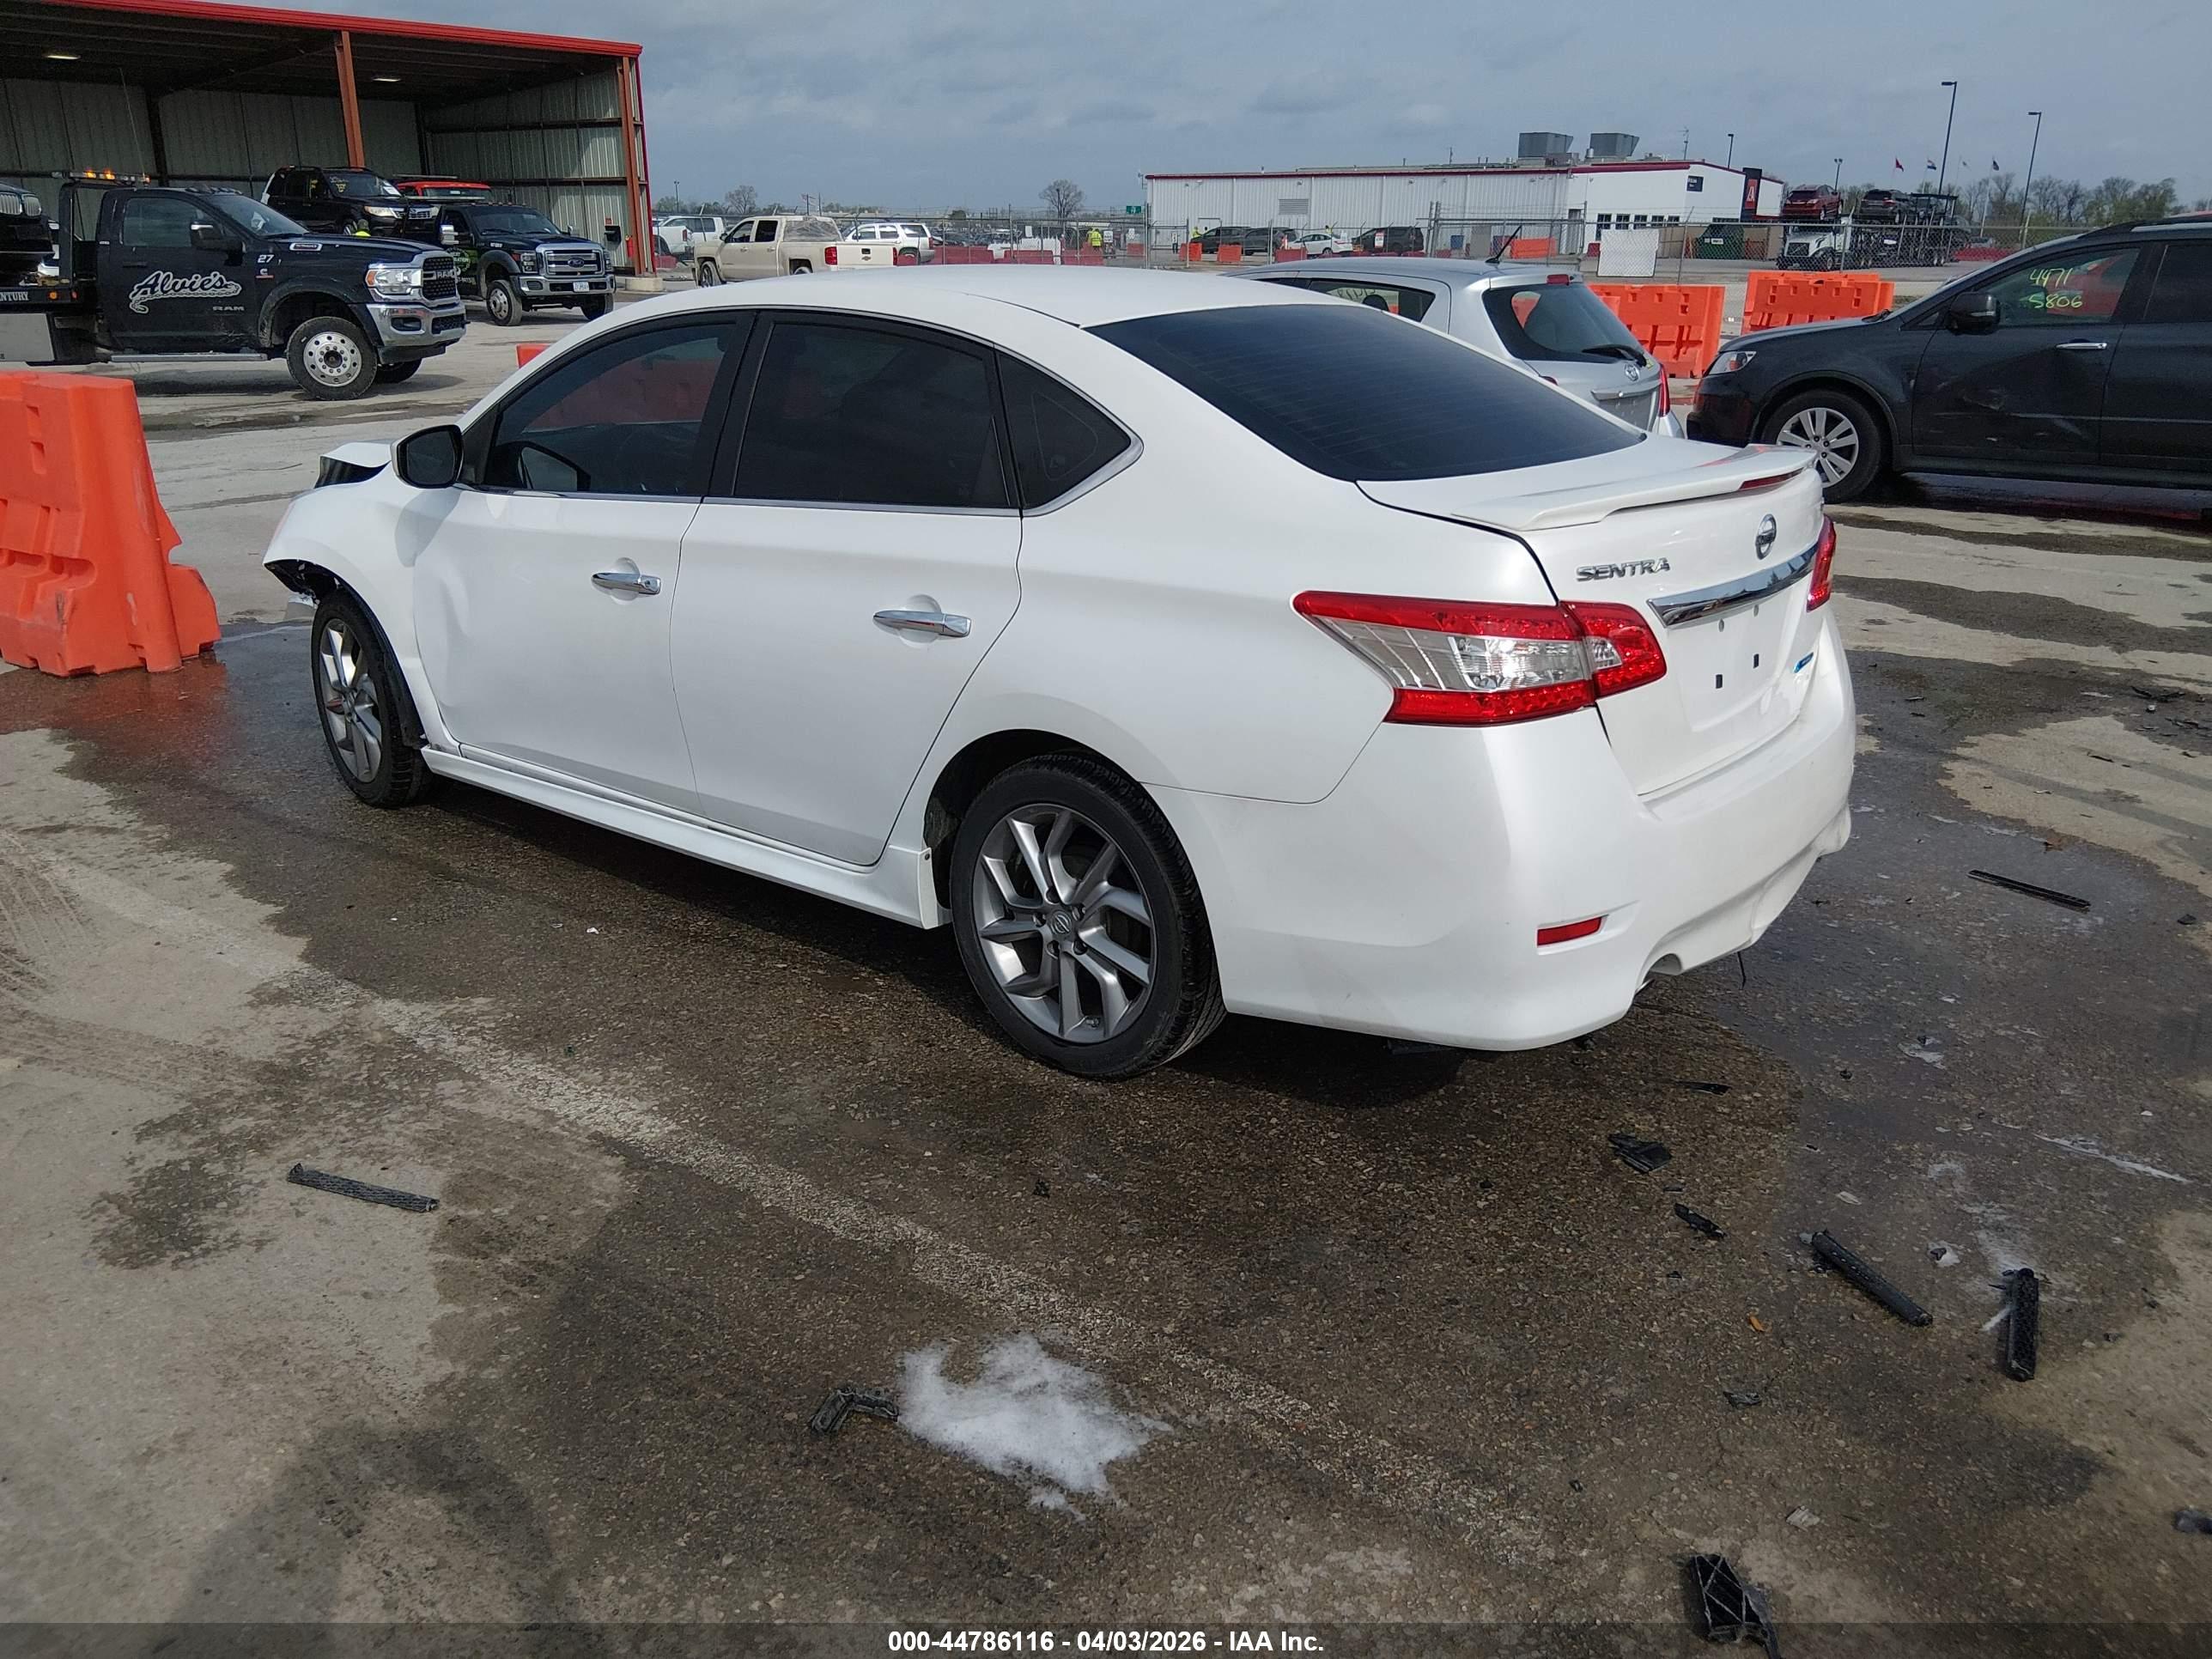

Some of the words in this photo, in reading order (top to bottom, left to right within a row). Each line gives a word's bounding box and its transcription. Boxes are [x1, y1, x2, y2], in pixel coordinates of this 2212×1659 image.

[258, 254, 274, 264] 27
[129, 270, 230, 300] Alvie's
[2028, 294, 2083, 309] 5806
[1576, 557, 1670, 582] SENTRA
